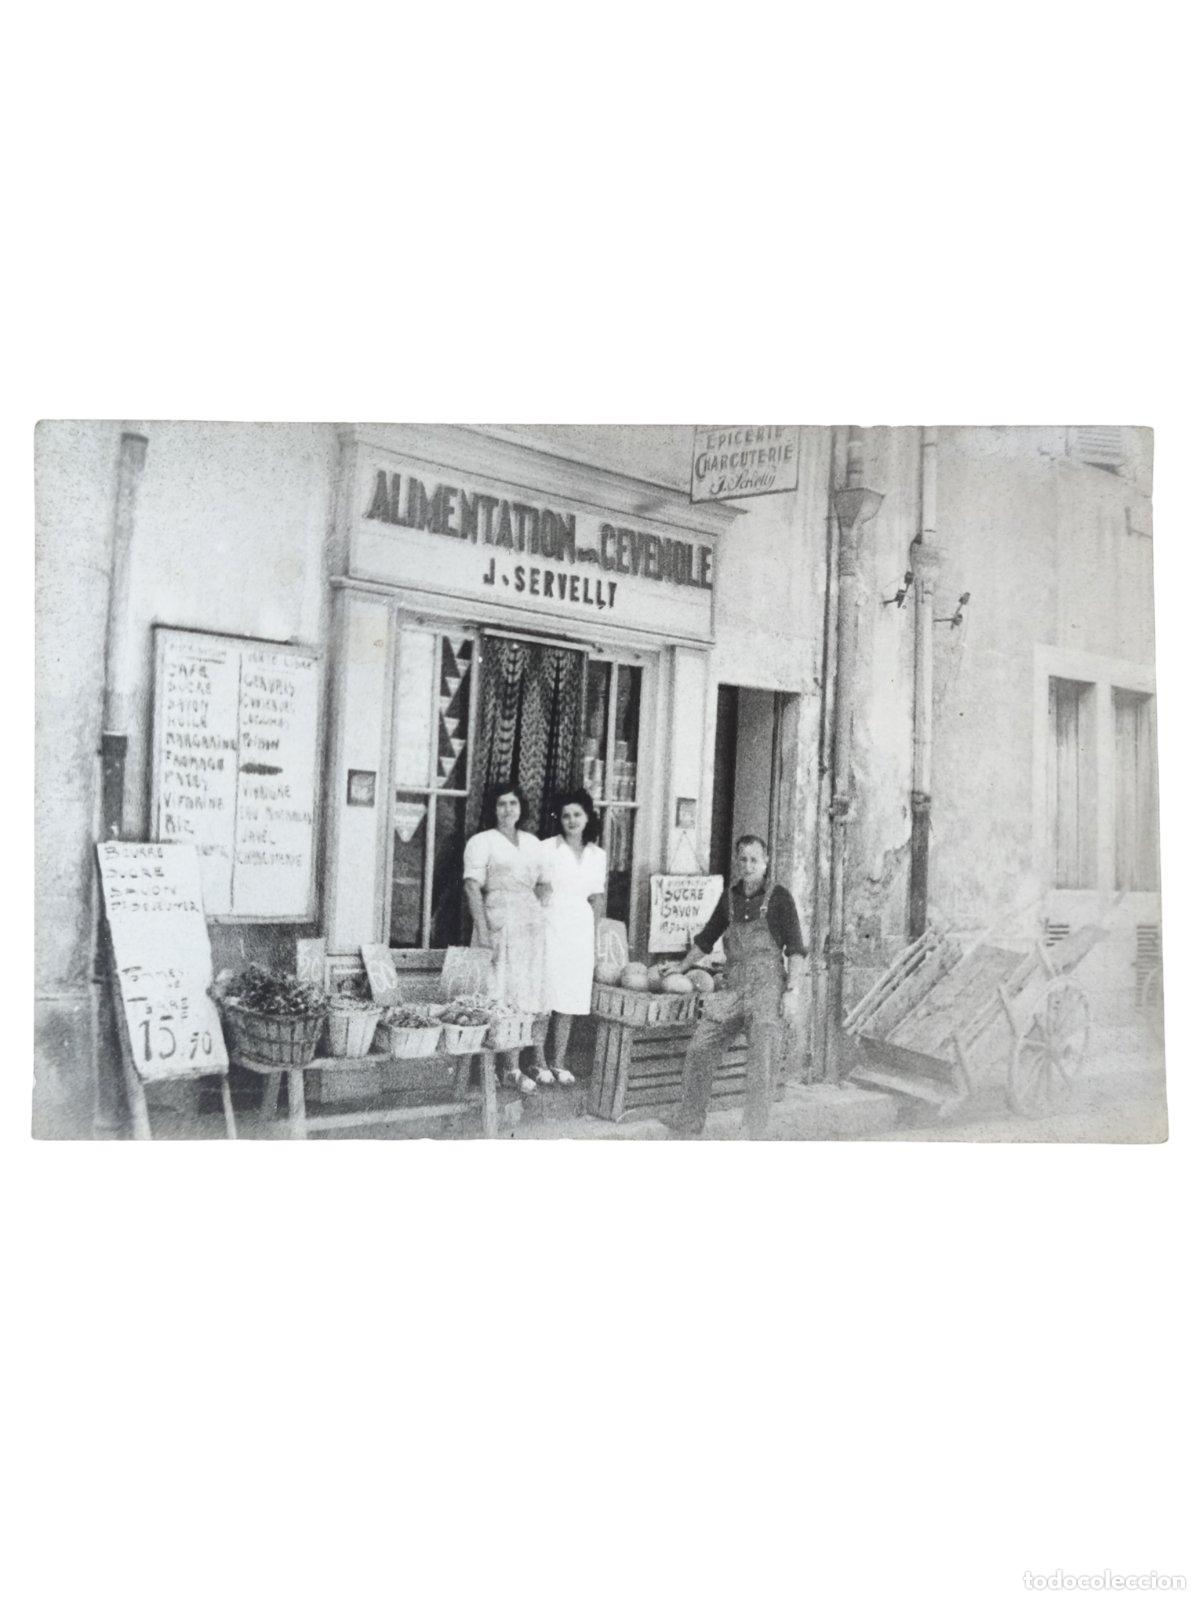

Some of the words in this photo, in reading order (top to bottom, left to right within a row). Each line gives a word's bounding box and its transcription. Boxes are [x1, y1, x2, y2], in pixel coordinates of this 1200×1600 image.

[695, 444, 793, 479] CHARCUTERIE
[366, 470, 576, 564] ALIMENTATION
[600, 523, 714, 591] CEVENOLE
[515, 565, 618, 610] SERVELLY
[166, 732, 238, 751] MARGARINE
[166, 750, 225, 772] FROMAGE
[165, 813, 195, 834] RIZ
[664, 888, 704, 902] SUCRE
[661, 905, 700, 919] SAVON
